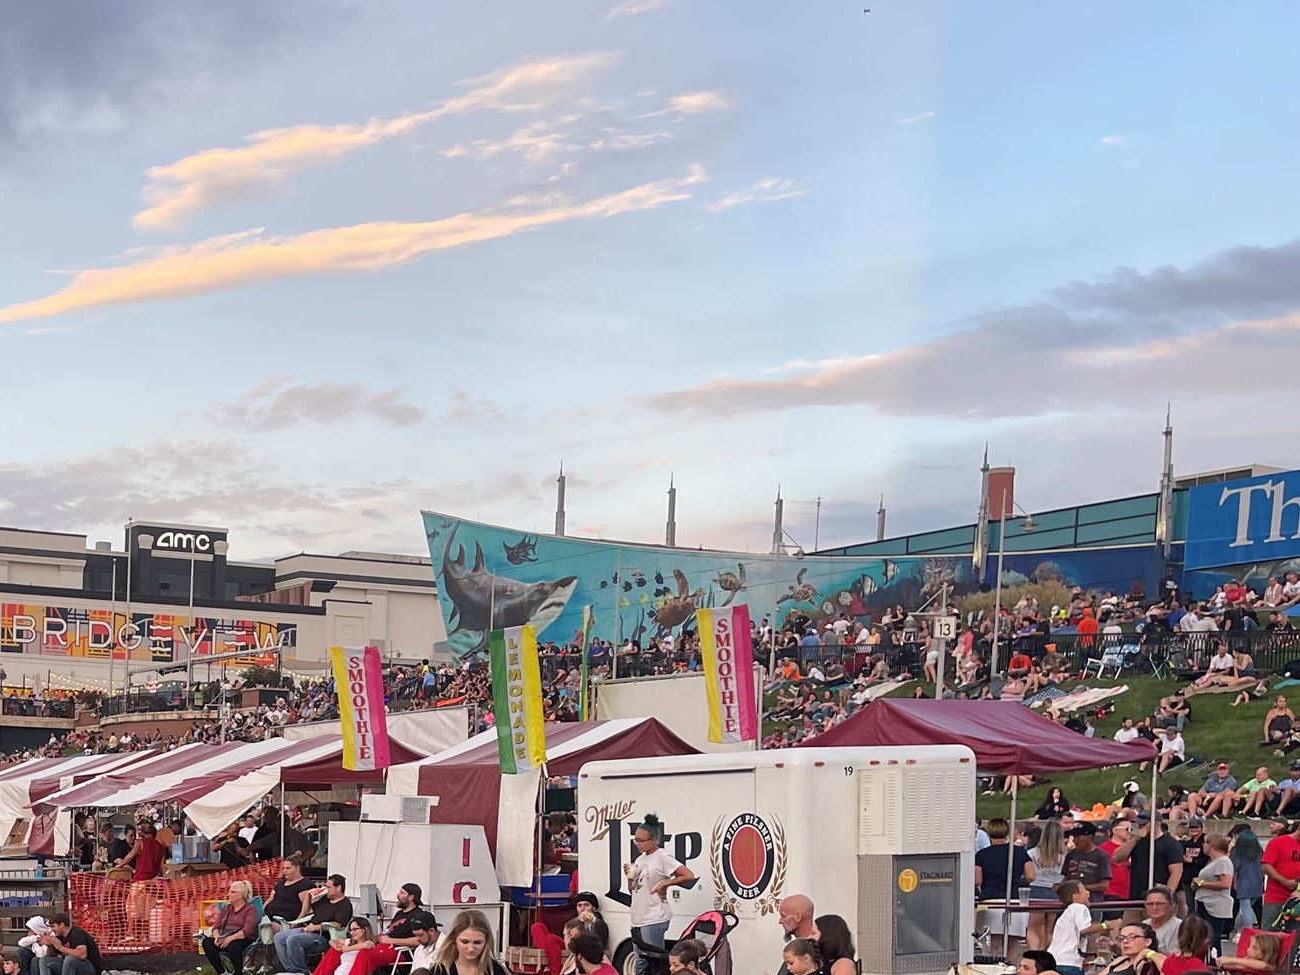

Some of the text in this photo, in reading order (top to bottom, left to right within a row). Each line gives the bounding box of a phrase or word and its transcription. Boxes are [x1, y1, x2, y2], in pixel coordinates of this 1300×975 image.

[939, 623, 951, 636] 13
[716, 618, 736, 733] SMOOTHIE
[349, 656, 371, 760] SMOOTHIE
[508, 637, 526, 760] LEMONADE
[844, 766, 853, 776] 19
[585, 800, 636, 836] Miller
[724, 815, 773, 852] A FINE PILSNER
[737, 887, 760, 898] BEER
